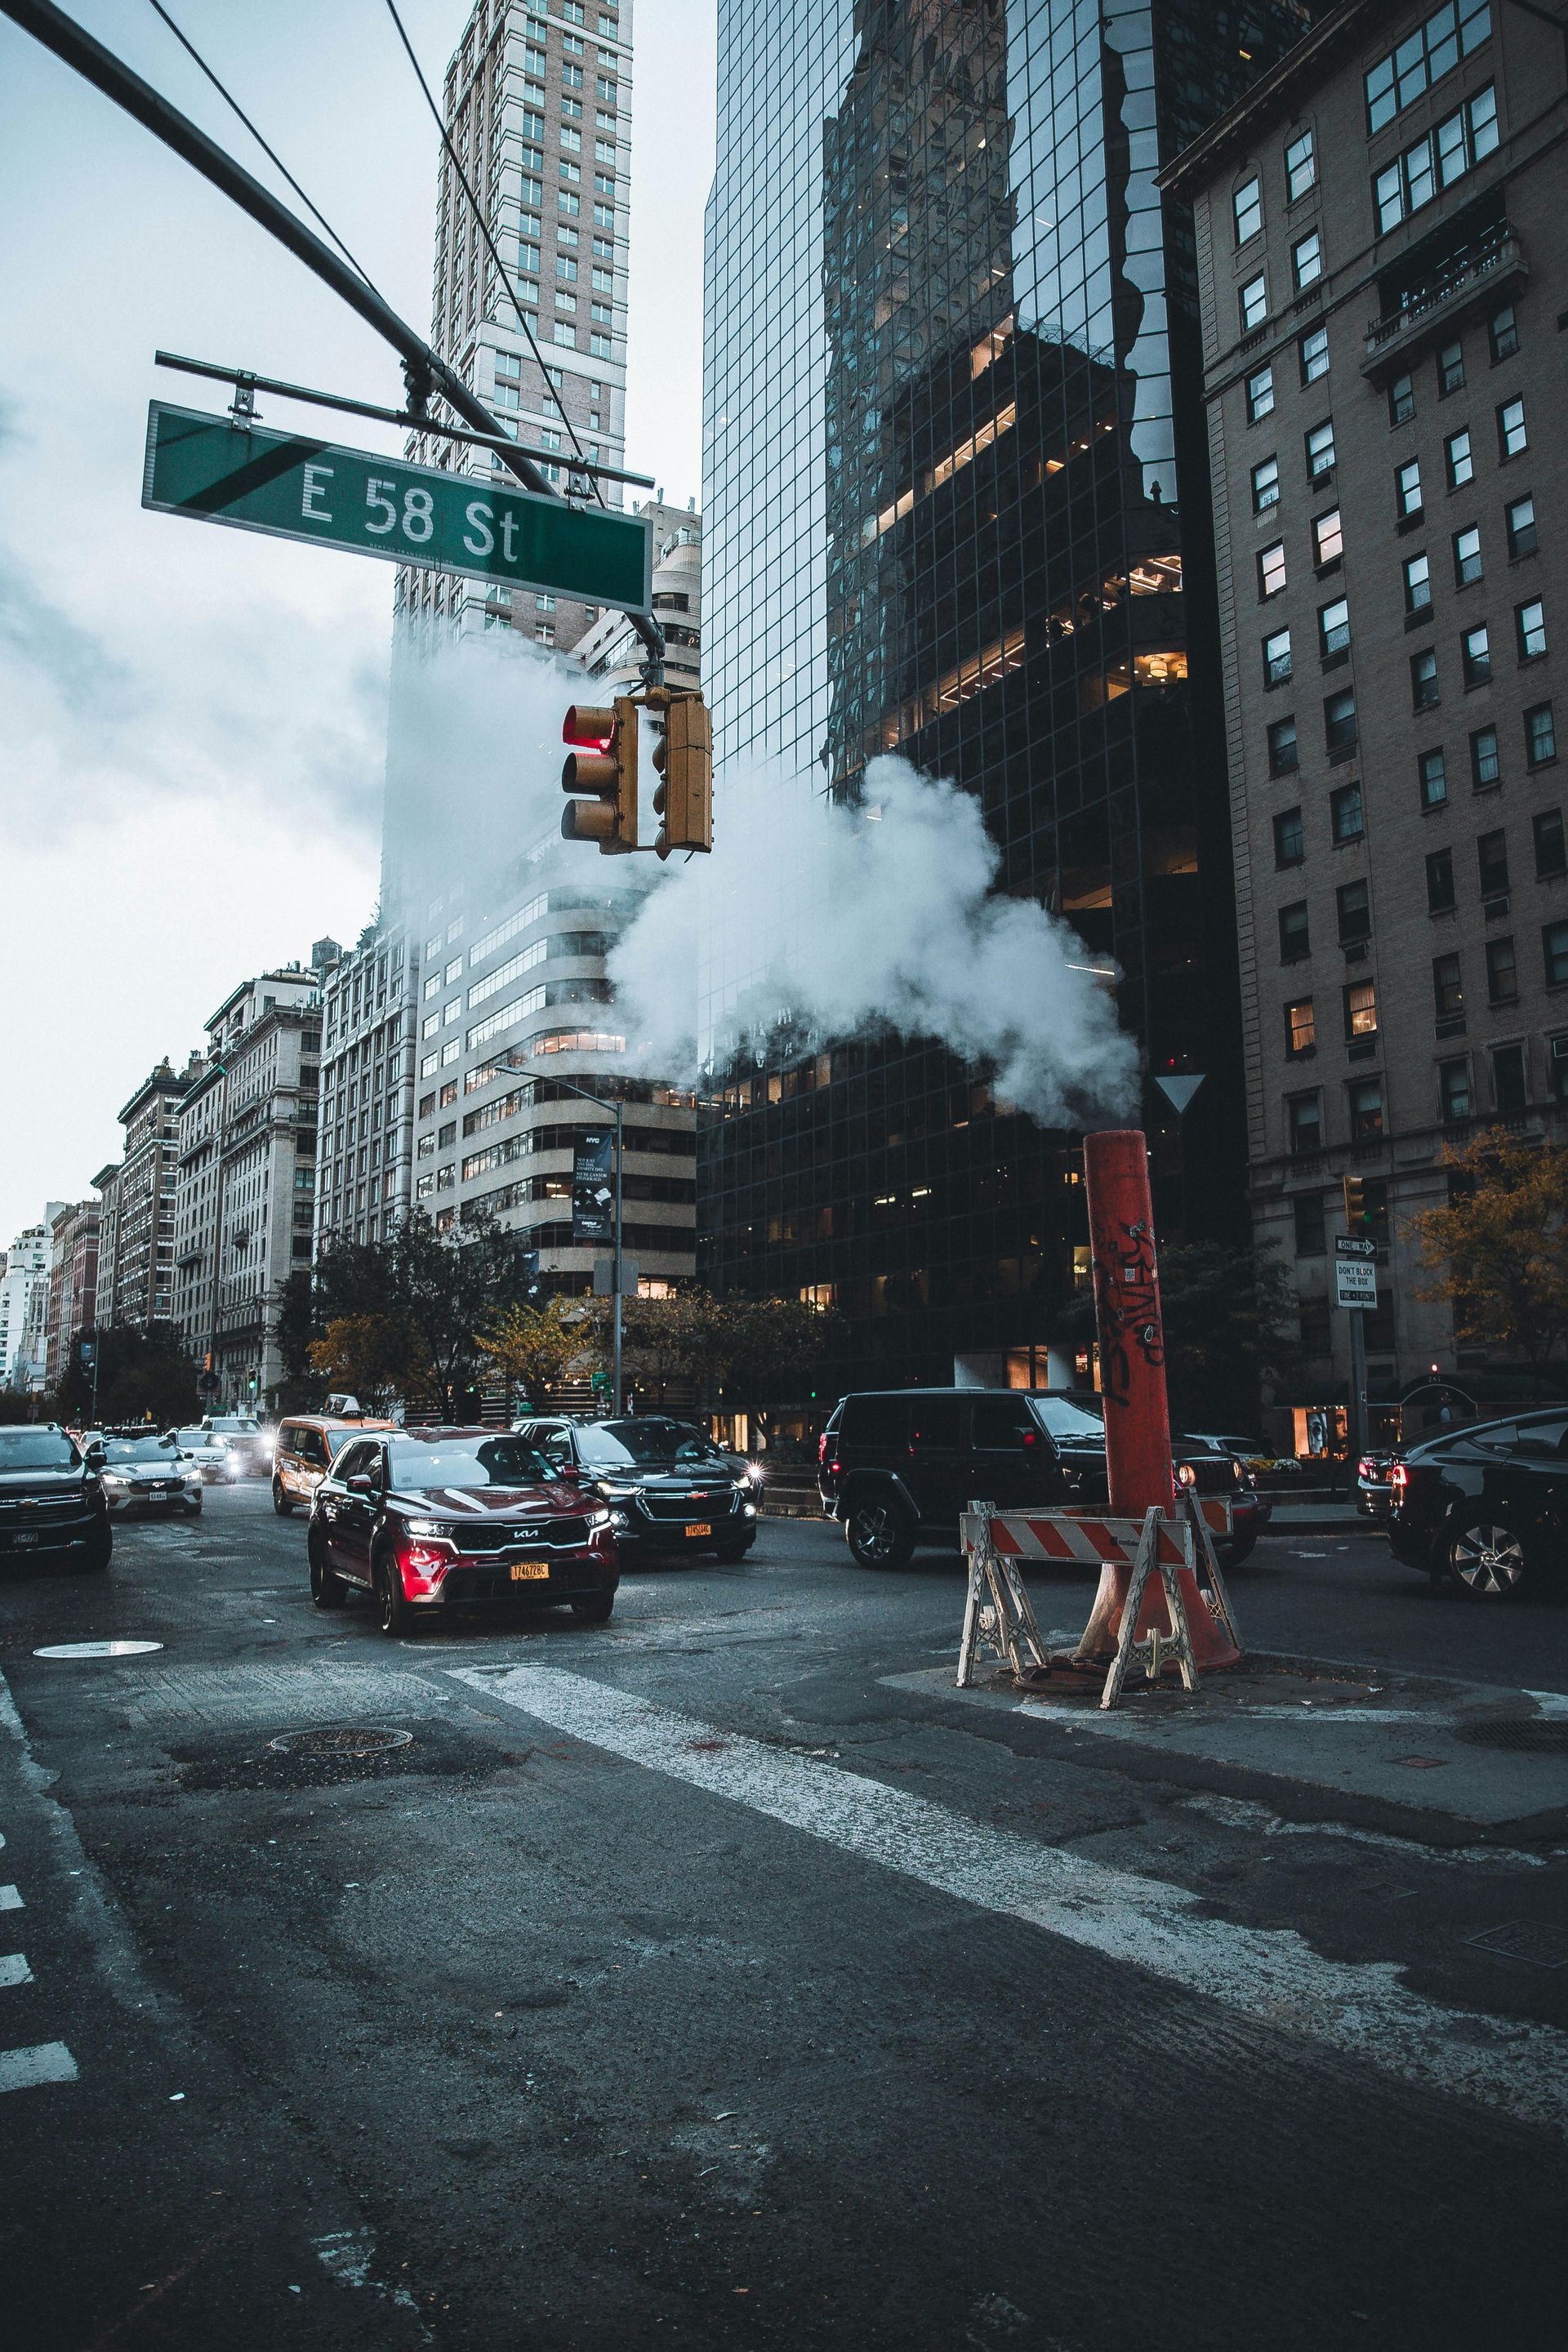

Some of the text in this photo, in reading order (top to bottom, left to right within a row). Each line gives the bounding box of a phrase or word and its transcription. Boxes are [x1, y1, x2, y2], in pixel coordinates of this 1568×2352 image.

[301, 462, 519, 564] E 58 St
[398, 549, 454, 565] TRANSPORTAION
[1341, 1241, 1371, 1251] ONE WAY
[1339, 1266, 1374, 1276] DON'T BLOCK
[1346, 1276, 1368, 1285] THE BOX
[1118, 1539, 1140, 1548] conEdis
